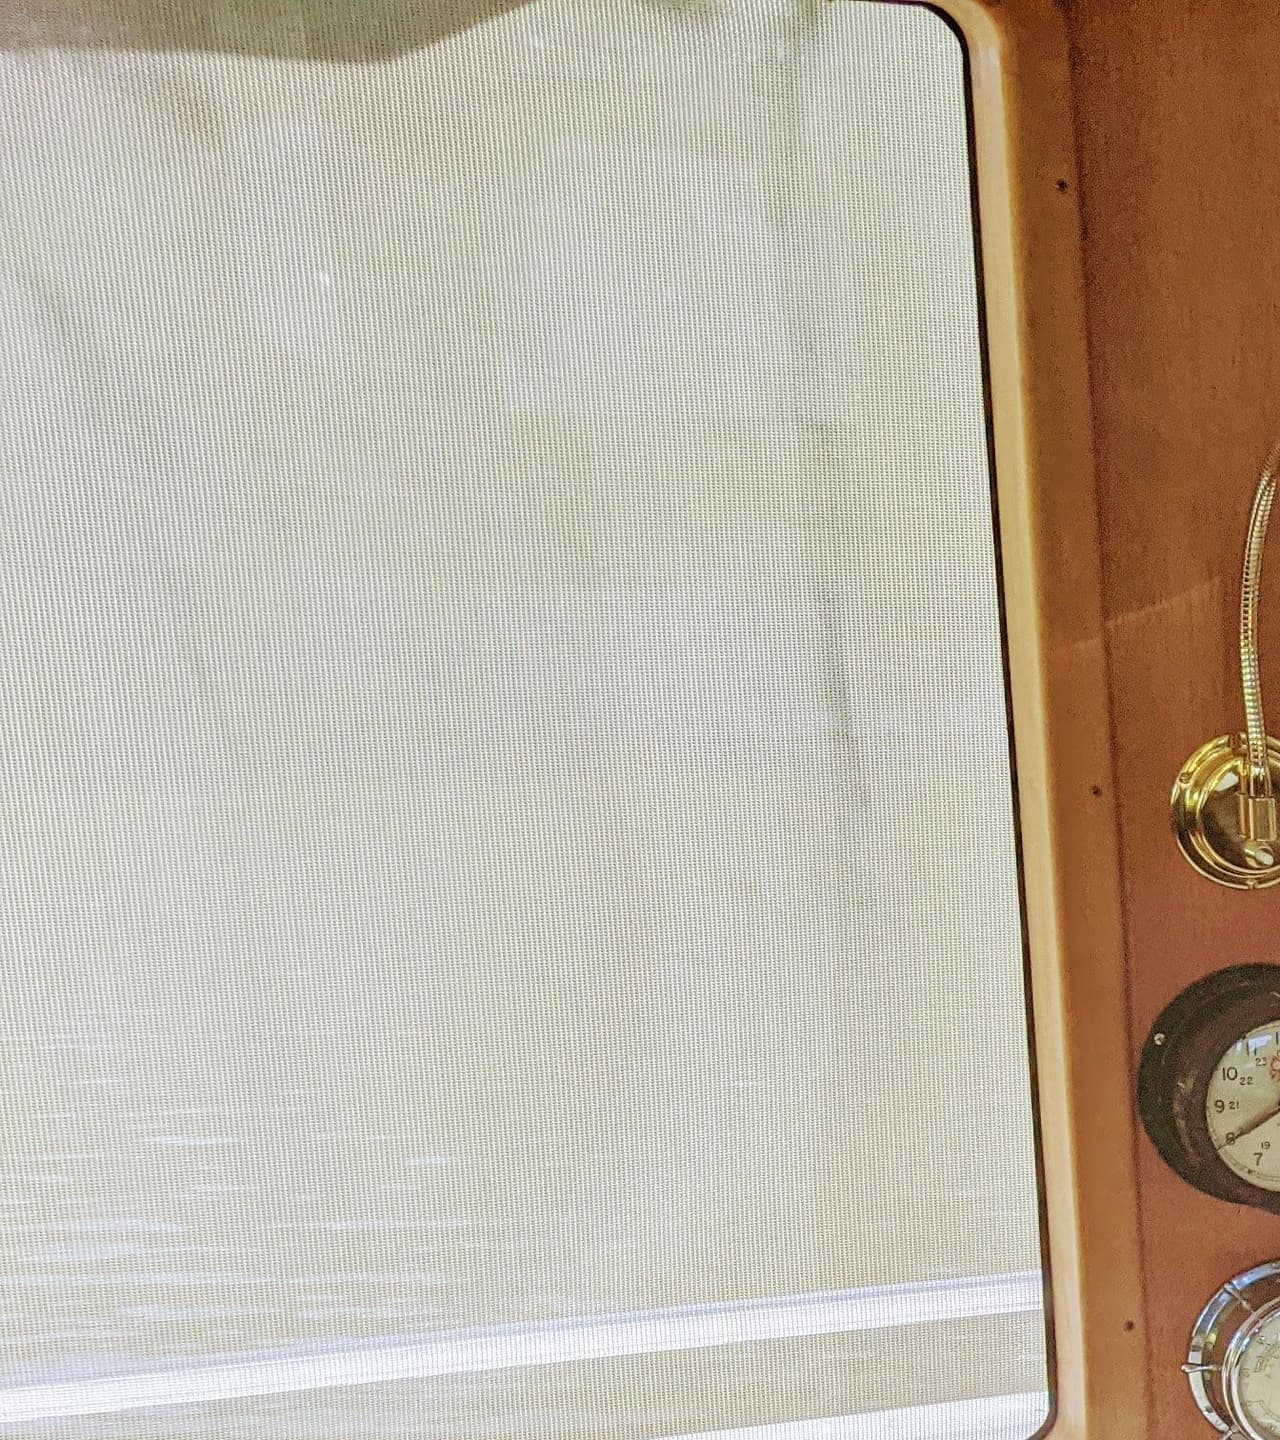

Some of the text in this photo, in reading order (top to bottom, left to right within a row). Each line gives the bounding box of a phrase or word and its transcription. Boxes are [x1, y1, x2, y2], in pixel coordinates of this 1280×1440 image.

[1221, 1066, 1238, 1082] 10
[1239, 1076, 1254, 1086] 22
[1214, 1100, 1225, 1114] 9
[1253, 1152, 1264, 1167] 7
